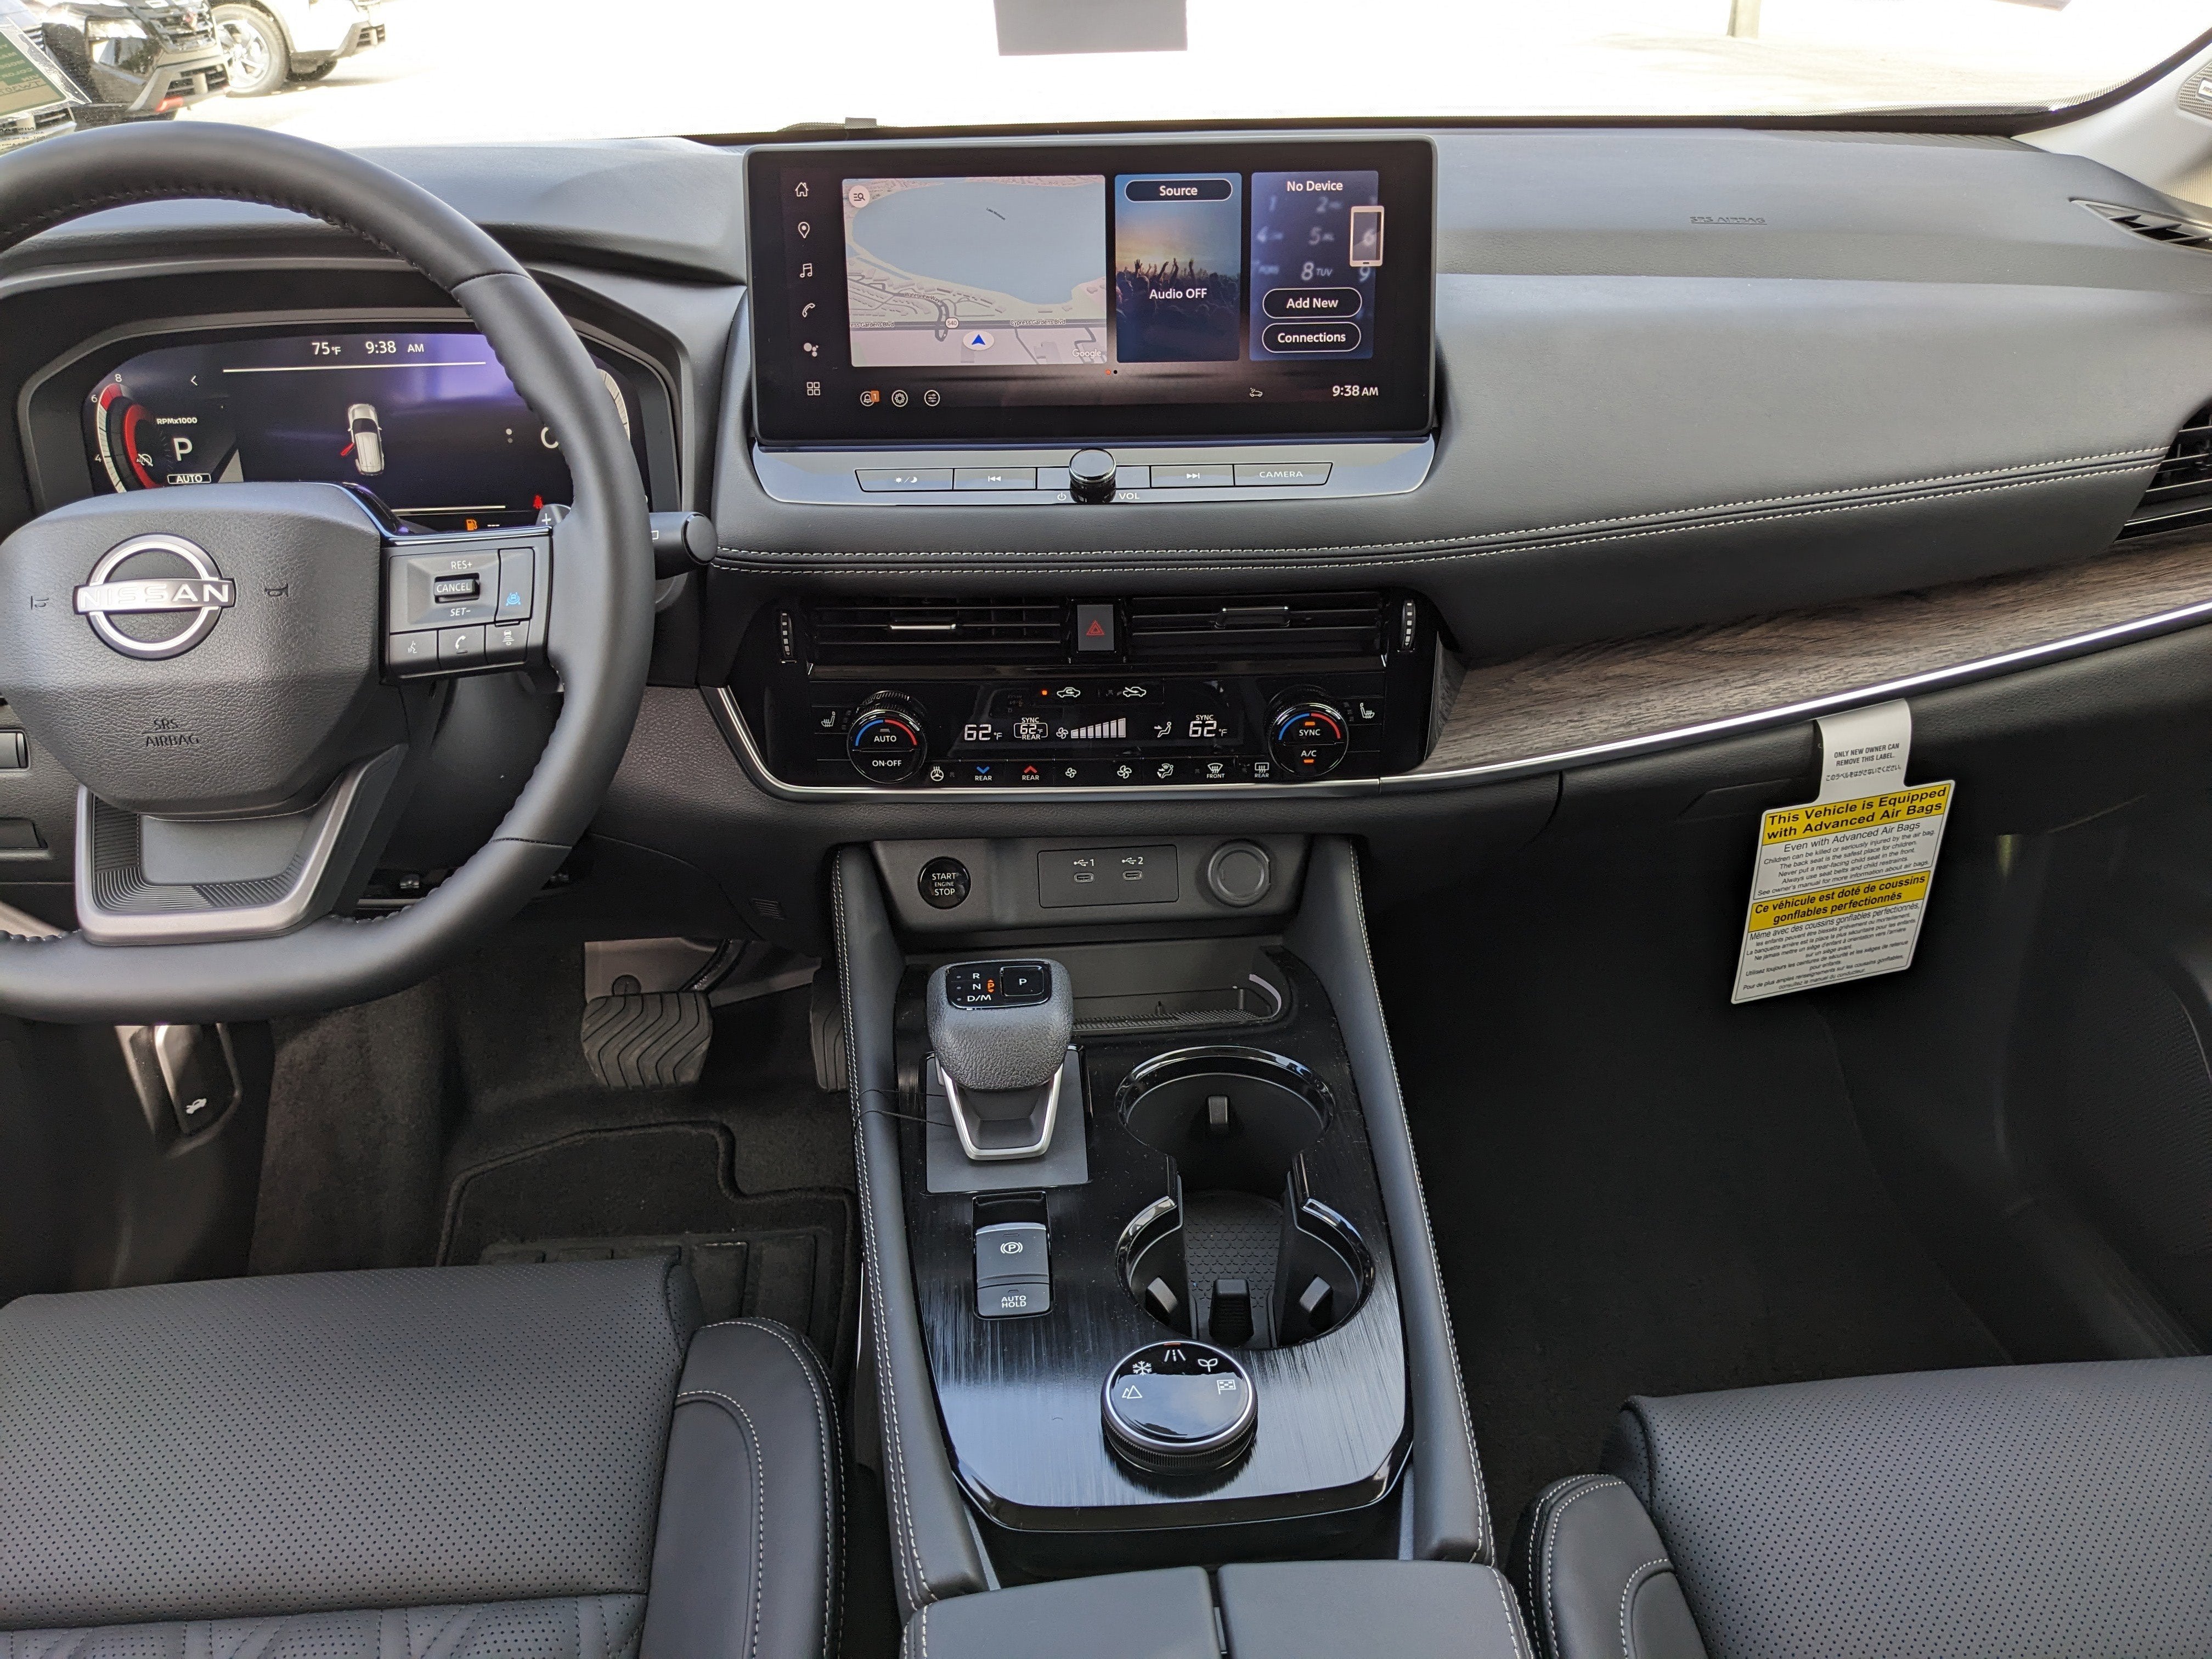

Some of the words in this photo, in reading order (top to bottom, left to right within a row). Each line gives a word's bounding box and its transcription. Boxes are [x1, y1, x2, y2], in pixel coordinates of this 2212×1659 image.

[1159, 185, 1198, 196] Source
[1287, 181, 1303, 191] No
[1306, 180, 1343, 191] Device
[1149, 289, 1183, 299] Audio
[1186, 288, 1207, 298] OFF
[1286, 298, 1310, 308] Add
[1313, 298, 1339, 308] New
[1277, 332, 1346, 343] Connections
[365, 341, 397, 354] 9:38
[408, 343, 424, 353] AM
[1073, 349, 1102, 359] Google
[115, 374, 122, 382] 8
[1333, 386, 1360, 397] 9:38
[1362, 387, 1379, 396] AM
[91, 394, 98, 403] 6
[173, 438, 193, 461] P
[95, 454, 101, 462] 4
[176, 475, 203, 483] AUTO
[437, 583, 471, 593] CANCEL
[81, 583, 229, 608] NISSAN
[153, 719, 179, 730] SRS
[145, 735, 200, 747] AIRBAG
[1833, 750, 1849, 758] ONLY
[1865, 744, 1886, 753] OWNER
[1836, 757, 1860, 766] REMOVE
[1769, 814, 1799, 825] This
[1805, 804, 1857, 819] Vehicle
[1861, 800, 1874, 810] is
[1878, 787, 1946, 807] Equipped
[1767, 826, 1797, 839] with
[1802, 812, 1875, 833] Advanced
[1879, 808, 1901, 820] Air
[1906, 803, 1942, 815] Bags
[1784, 842, 1808, 853] Even
[1810, 837, 1830, 847] with
[1831, 828, 1879, 844] Advanced
[1880, 826, 1895, 835] Air
[1897, 822, 1920, 832] Bags
[1763, 856, 1791, 865] Children
[1814, 847, 1831, 855] killed
[1840, 841, 1869, 851] seriously
[1870, 837, 1891, 846] injured
[1137, 856, 1143, 865] 2
[1793, 859, 1808, 867] back
[1843, 850, 1863, 858] safest
[1863, 847, 1881, 855] place
[932, 872, 956, 881] START
[1754, 904, 1769, 914] Ce
[1772, 895, 1816, 911] véhicule
[1818, 891, 1835, 902] est
[1837, 885, 1860, 899] doté
[1863, 883, 1876, 894] de
[1878, 876, 1925, 890] coussins
[1773, 906, 1828, 925] gonflables
[1830, 892, 1902, 914] perfectionnés
